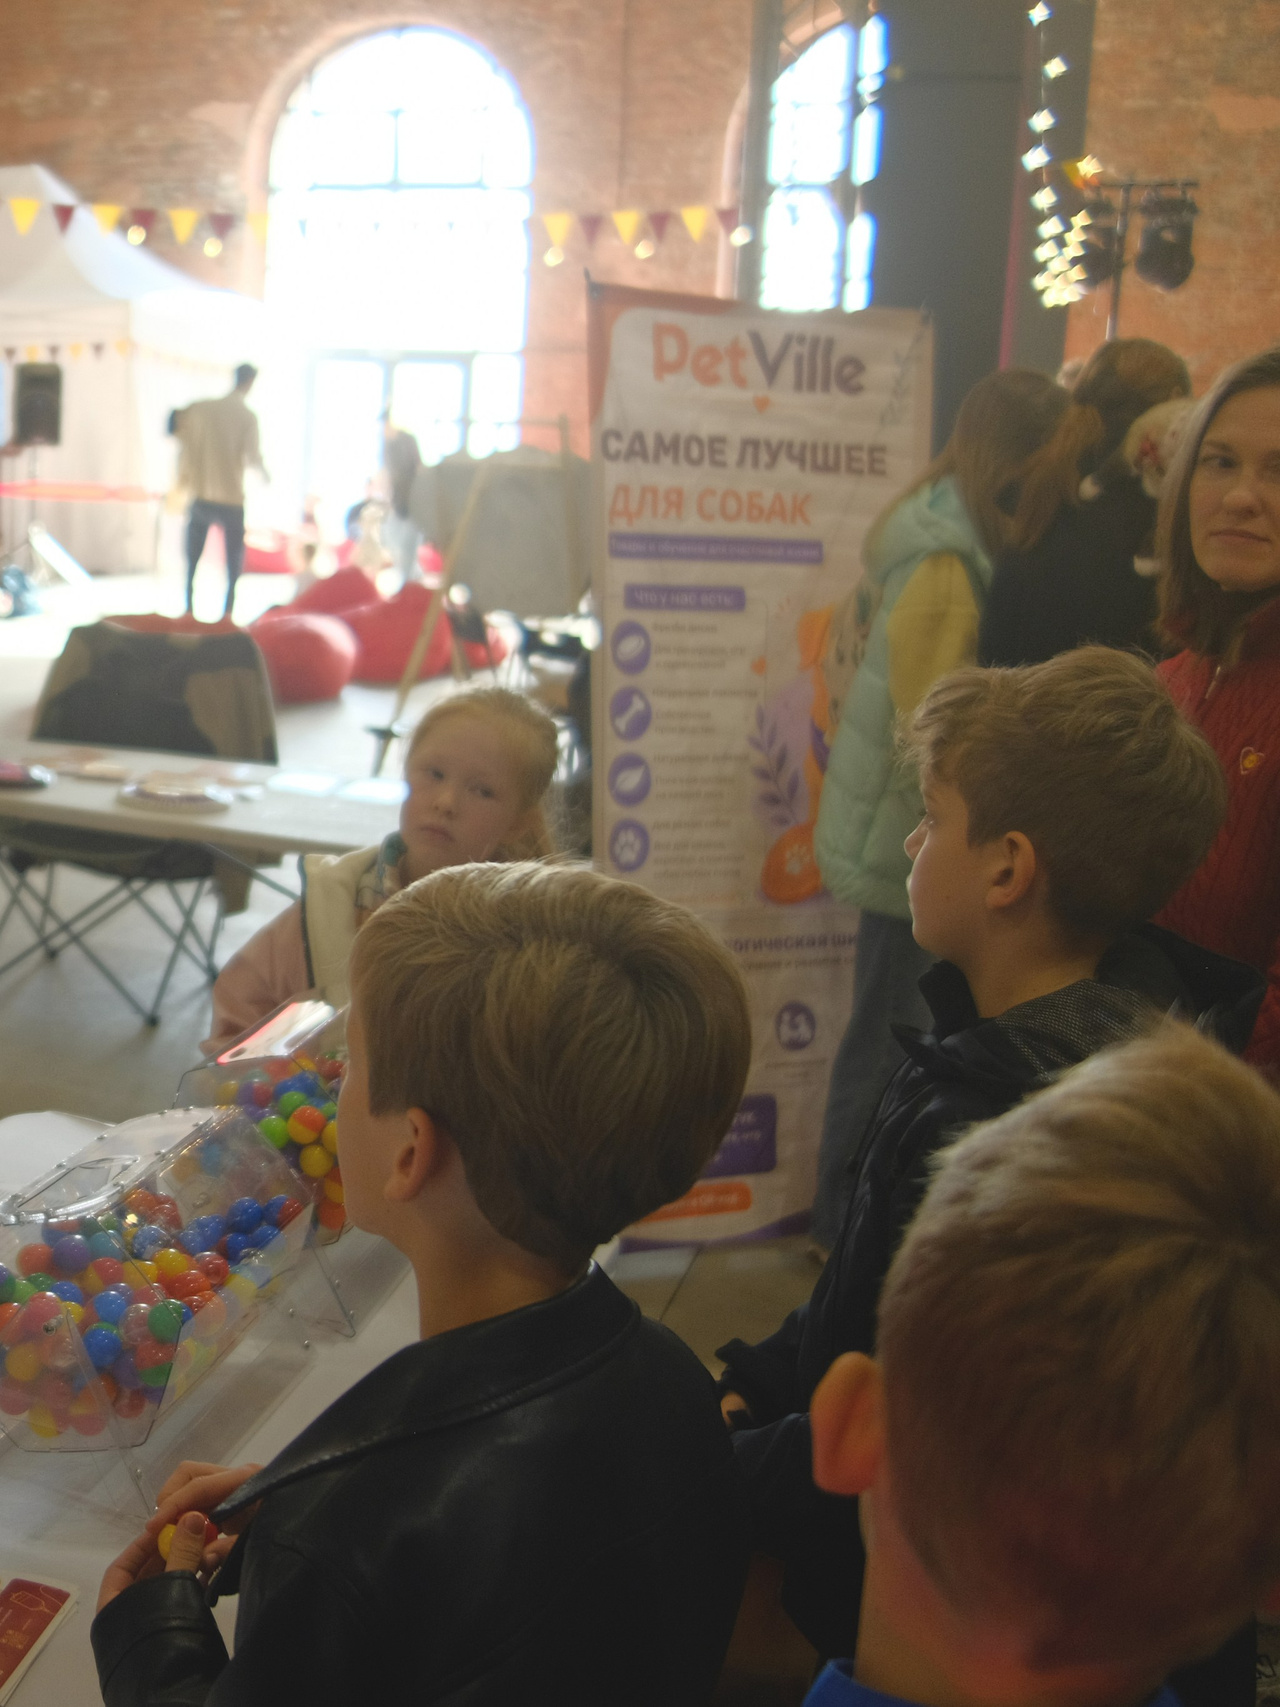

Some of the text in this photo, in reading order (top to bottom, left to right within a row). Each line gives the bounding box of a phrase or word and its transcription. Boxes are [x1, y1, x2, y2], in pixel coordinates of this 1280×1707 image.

[651, 321, 866, 396] PetVille
[600, 428, 888, 477] САМОЕ ЛУЧШЕЕ
[608, 483, 813, 527] ДЛЯ СОБАК
